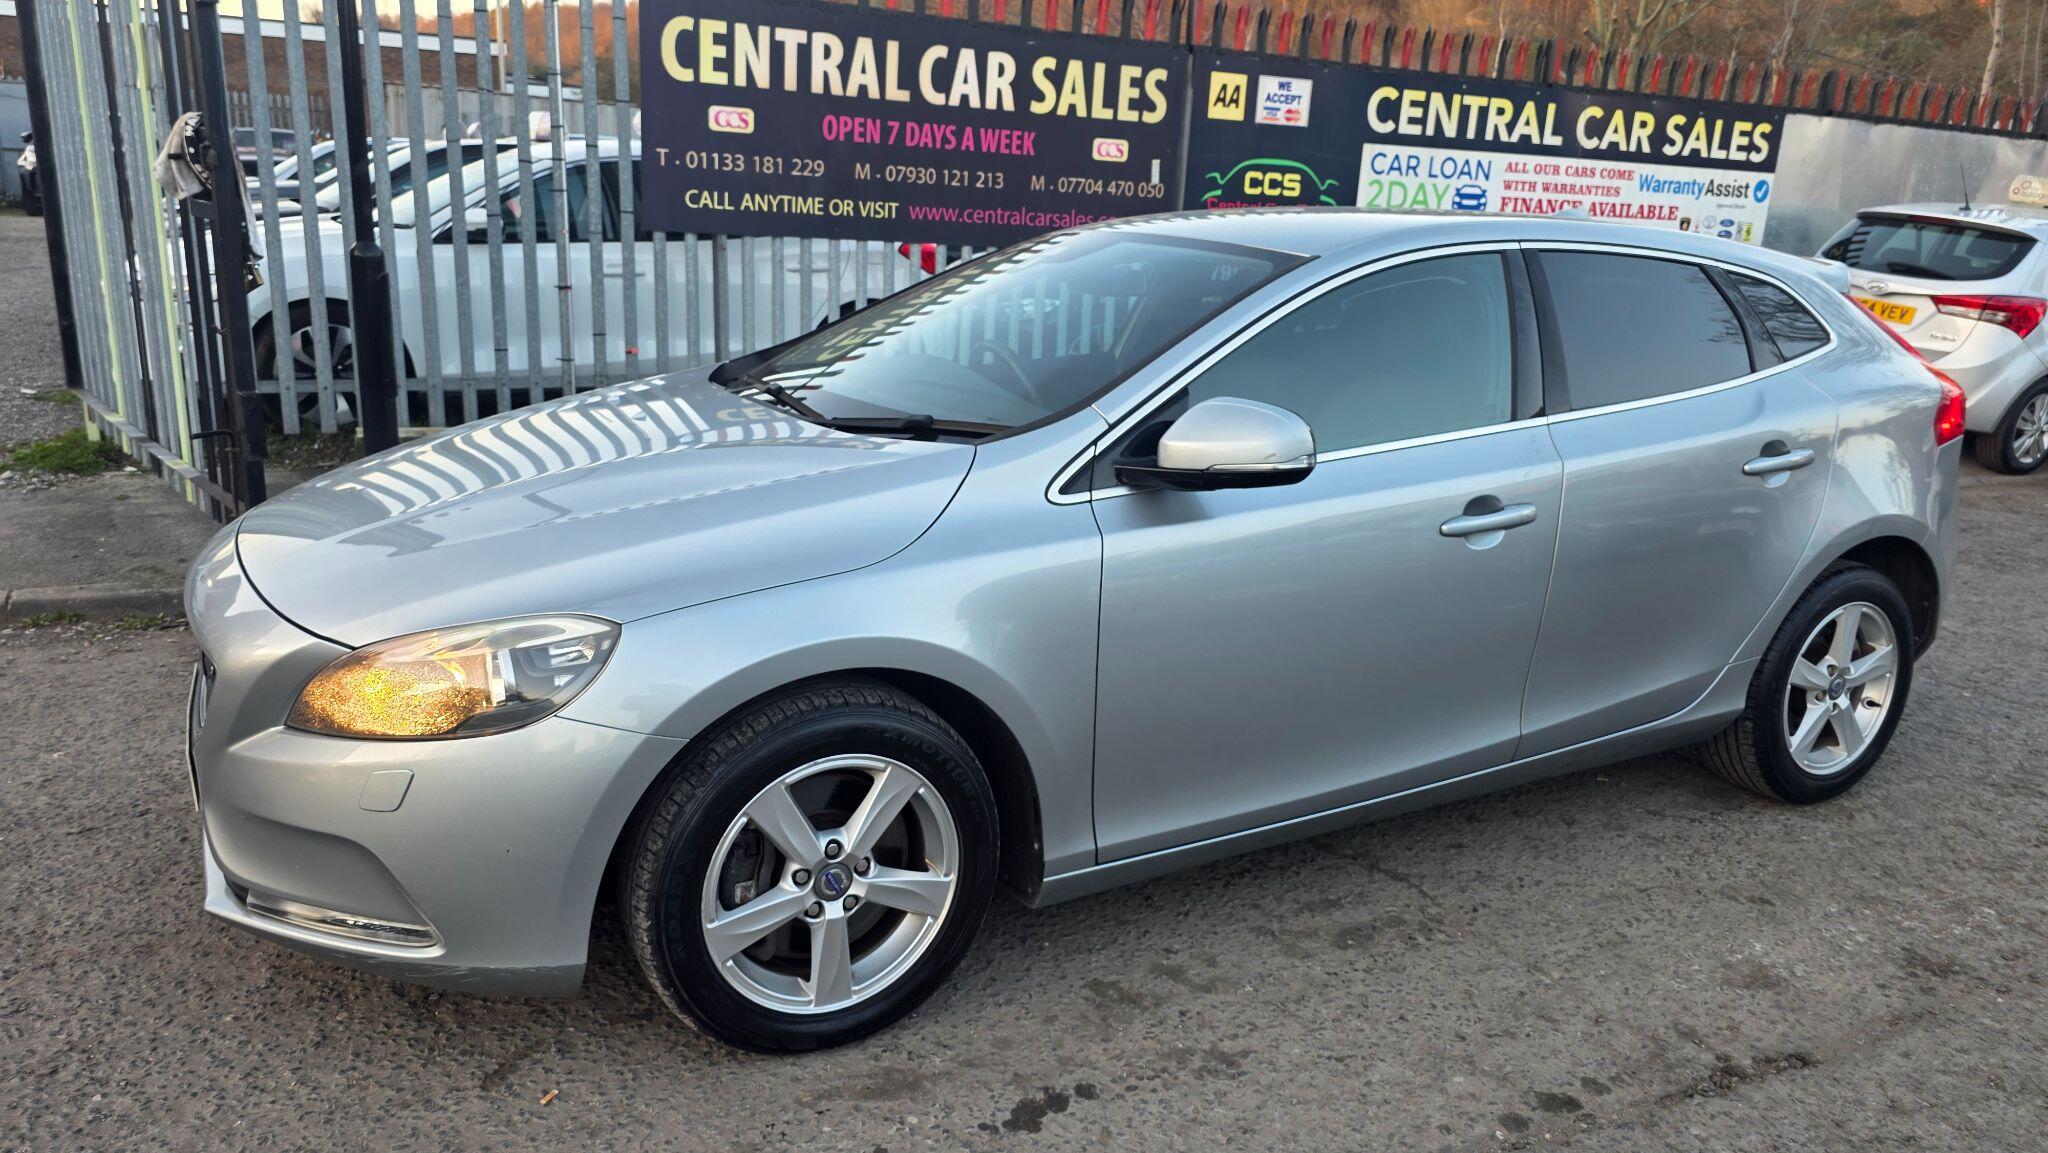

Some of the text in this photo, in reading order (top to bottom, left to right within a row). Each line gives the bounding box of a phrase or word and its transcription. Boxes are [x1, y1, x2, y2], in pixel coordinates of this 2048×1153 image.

[660, 15, 1169, 124] CENTRAL CAR SALES
[1213, 83, 1241, 109] AA
[1264, 92, 1303, 106] ACCEPT
[1277, 81, 1293, 92] WE
[714, 109, 750, 130] CCS
[1367, 85, 1774, 164] CENTRAL CAR SALES
[822, 113, 1036, 156] OPEN 7 DAYS A WEEK
[1096, 141, 1125, 159] CCS
[685, 150, 746, 172] 01133
[752, 155, 784, 175] 181
[790, 158, 826, 178] 229
[1370, 152, 1493, 182] CAR LOAN
[1504, 161, 1635, 181] ALL OUR CARS COME
[885, 165, 937, 185] 07930
[943, 169, 969, 187] 121
[975, 171, 1005, 190] 213
[1057, 176, 1104, 195] 07704
[1107, 180, 1135, 197] 470
[1137, 182, 1165, 199] 050
[1243, 170, 1302, 198] CCS
[1503, 179, 1621, 198] WITH WARRANTIES
[684, 189, 900, 220] CALL ANYTIME OR VISIT
[1366, 178, 1451, 210] 2DAY
[1588, 201, 1679, 221] AVAILABLE
